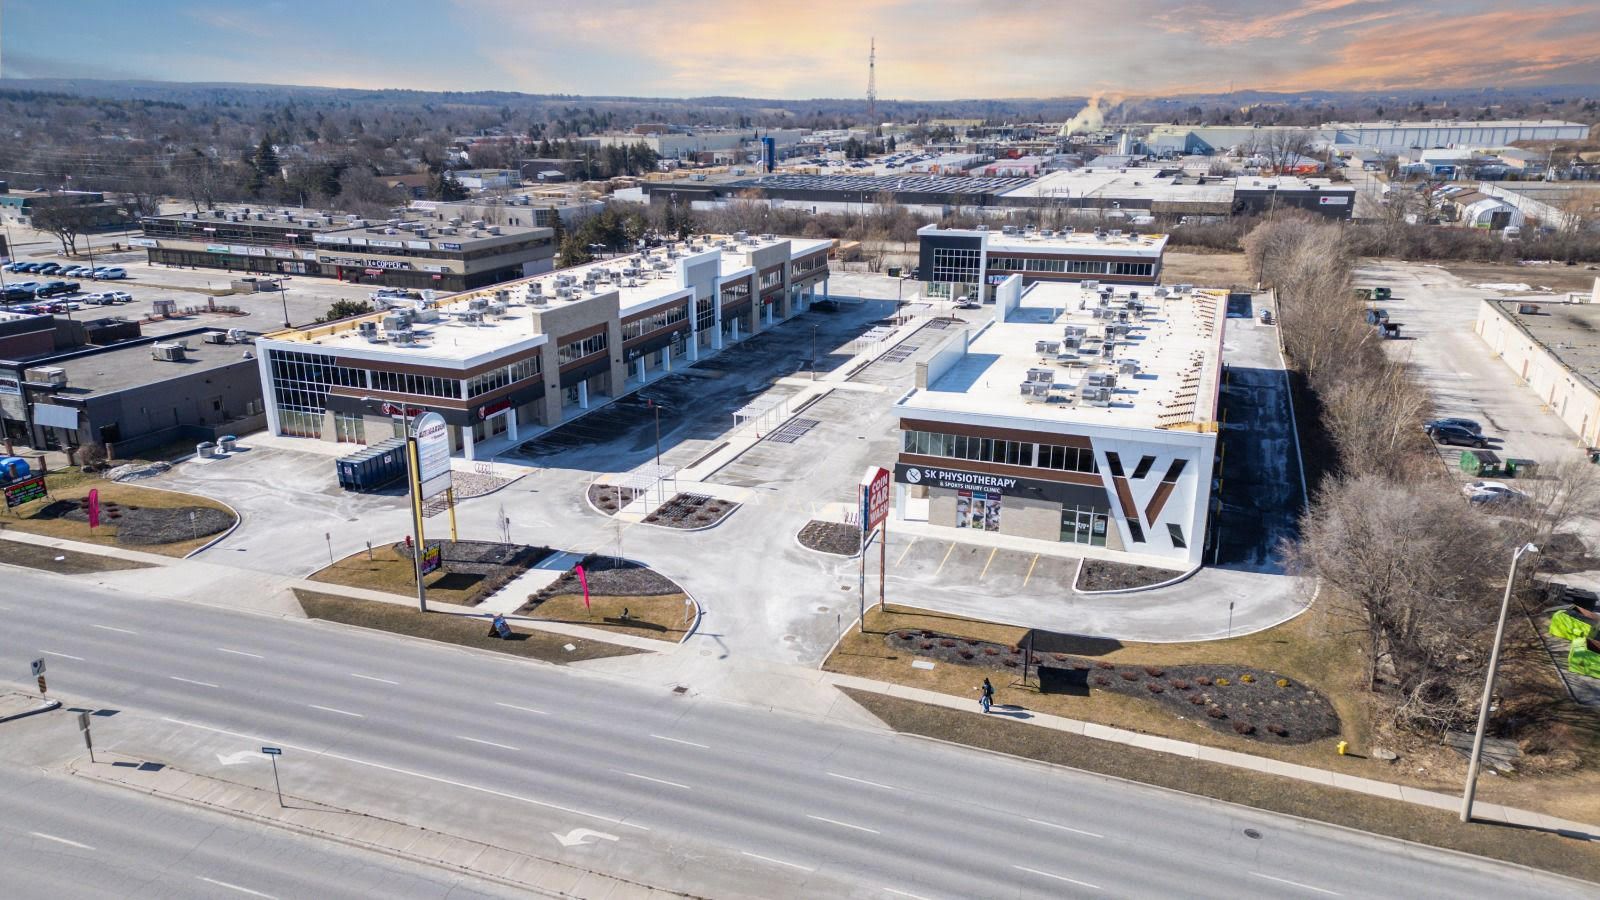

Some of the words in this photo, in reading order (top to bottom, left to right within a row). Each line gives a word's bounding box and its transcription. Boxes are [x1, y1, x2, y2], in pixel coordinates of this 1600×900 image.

[376, 260, 401, 269] COPPER
[871, 473, 888, 493] COIN
[924, 469, 937, 479] SK
[939, 470, 1017, 488] PHYSIOTHERAPY
[870, 485, 888, 511] CAR
[870, 501, 889, 524] WASH
